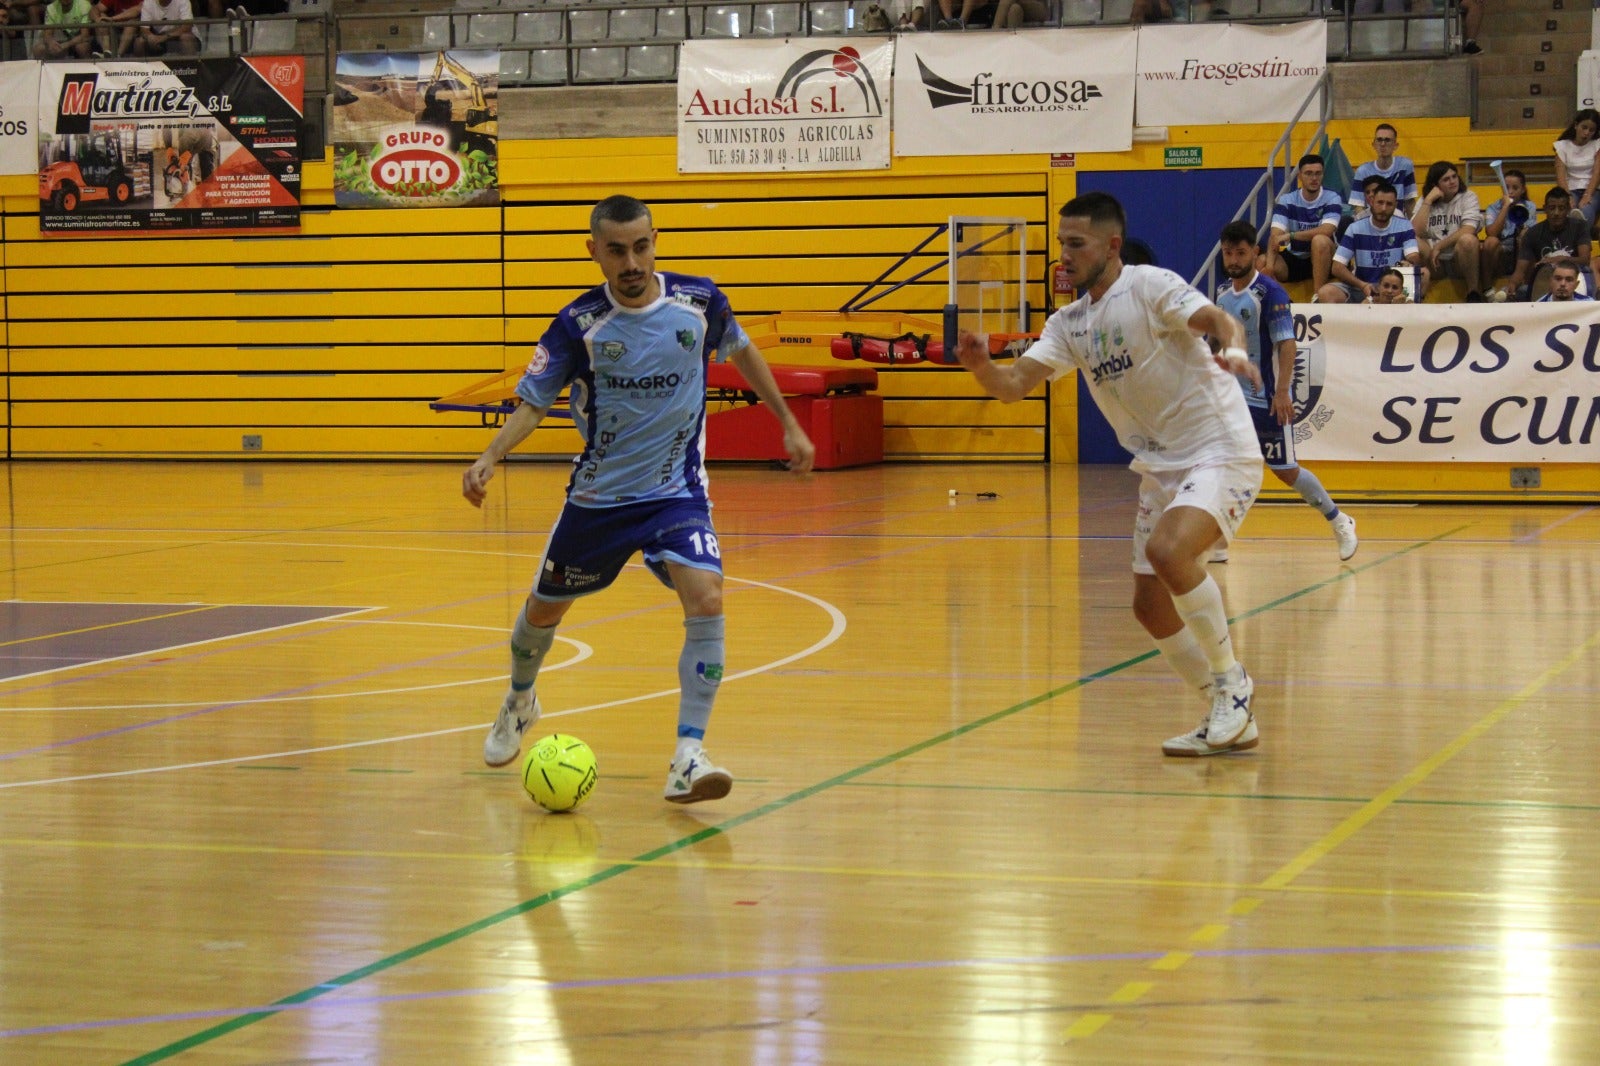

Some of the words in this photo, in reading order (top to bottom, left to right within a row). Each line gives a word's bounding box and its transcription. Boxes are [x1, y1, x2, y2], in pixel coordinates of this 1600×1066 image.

[971, 72, 1090, 106] fircosa
[685, 88, 799, 116] Audasa
[811, 86, 845, 114] s.l.
[971, 105, 1064, 114] DESARROLLOS
[240, 127, 268, 135] STIHL
[253, 136, 296, 144] HONDA
[386, 131, 445, 147] GRUPO
[697, 127, 785, 144] SUMINISTROS
[798, 125, 873, 142] AGRICOLAS
[730, 149, 745, 164] 950
[749, 149, 760, 164] 58
[763, 149, 774, 164] 30
[777, 148, 788, 163] 49
[798, 148, 810, 163] LA
[817, 146, 862, 162] ALDEILLA
[1165, 157, 1202, 165] EMERGENCIA
[1190, 149, 1198, 157] DE
[241, 174, 270, 182] ALQUILER
[380, 160, 451, 185] OTTO
[1380, 325, 1515, 374] LOS
[1372, 396, 1462, 445] SE
[1264, 442, 1283, 460] 21
[689, 531, 721, 559] 18
